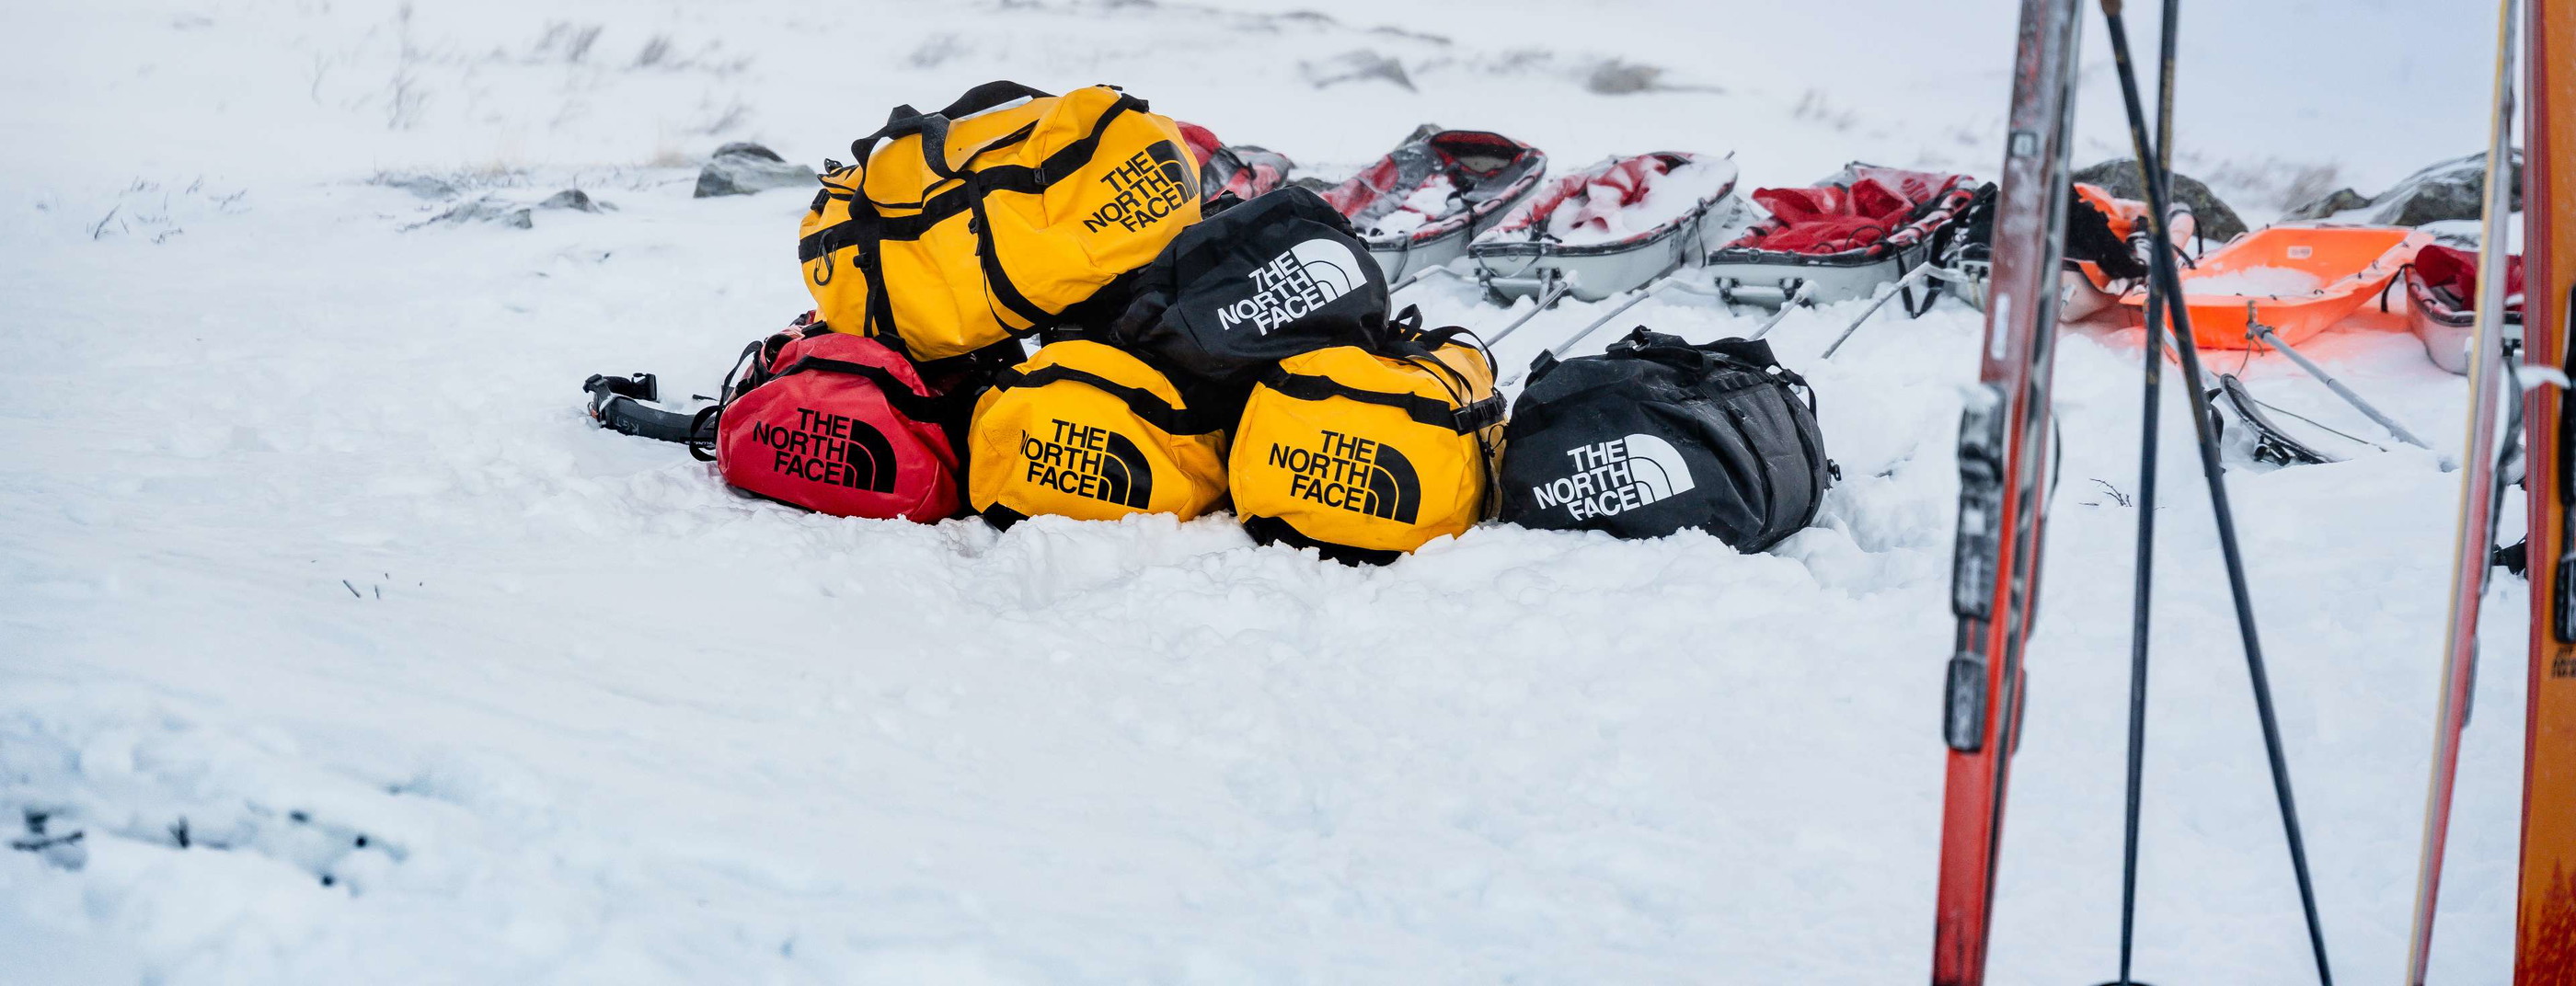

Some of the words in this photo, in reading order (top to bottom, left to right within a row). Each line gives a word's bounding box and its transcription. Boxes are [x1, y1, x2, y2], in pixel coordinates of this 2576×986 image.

[1100, 151, 1155, 193] THE
[1083, 169, 1169, 234] NORTH
[1120, 187, 1182, 233] FACE
[1248, 250, 1300, 292] THE
[1217, 269, 1313, 330] NORTH
[1253, 285, 1326, 337] FACE
[753, 420, 845, 462] NORTH
[798, 407, 850, 439] THE
[1052, 418, 1106, 452] THE
[1269, 442, 1370, 487] NORTH
[1321, 430, 1375, 464] THE
[1567, 439, 1626, 472] THE
[774, 451, 842, 486] FACE
[1027, 461, 1097, 499] FACE
[1533, 461, 1632, 510] NORTH
[1290, 474, 1364, 512] FACE
[1567, 484, 1640, 522] FACE
